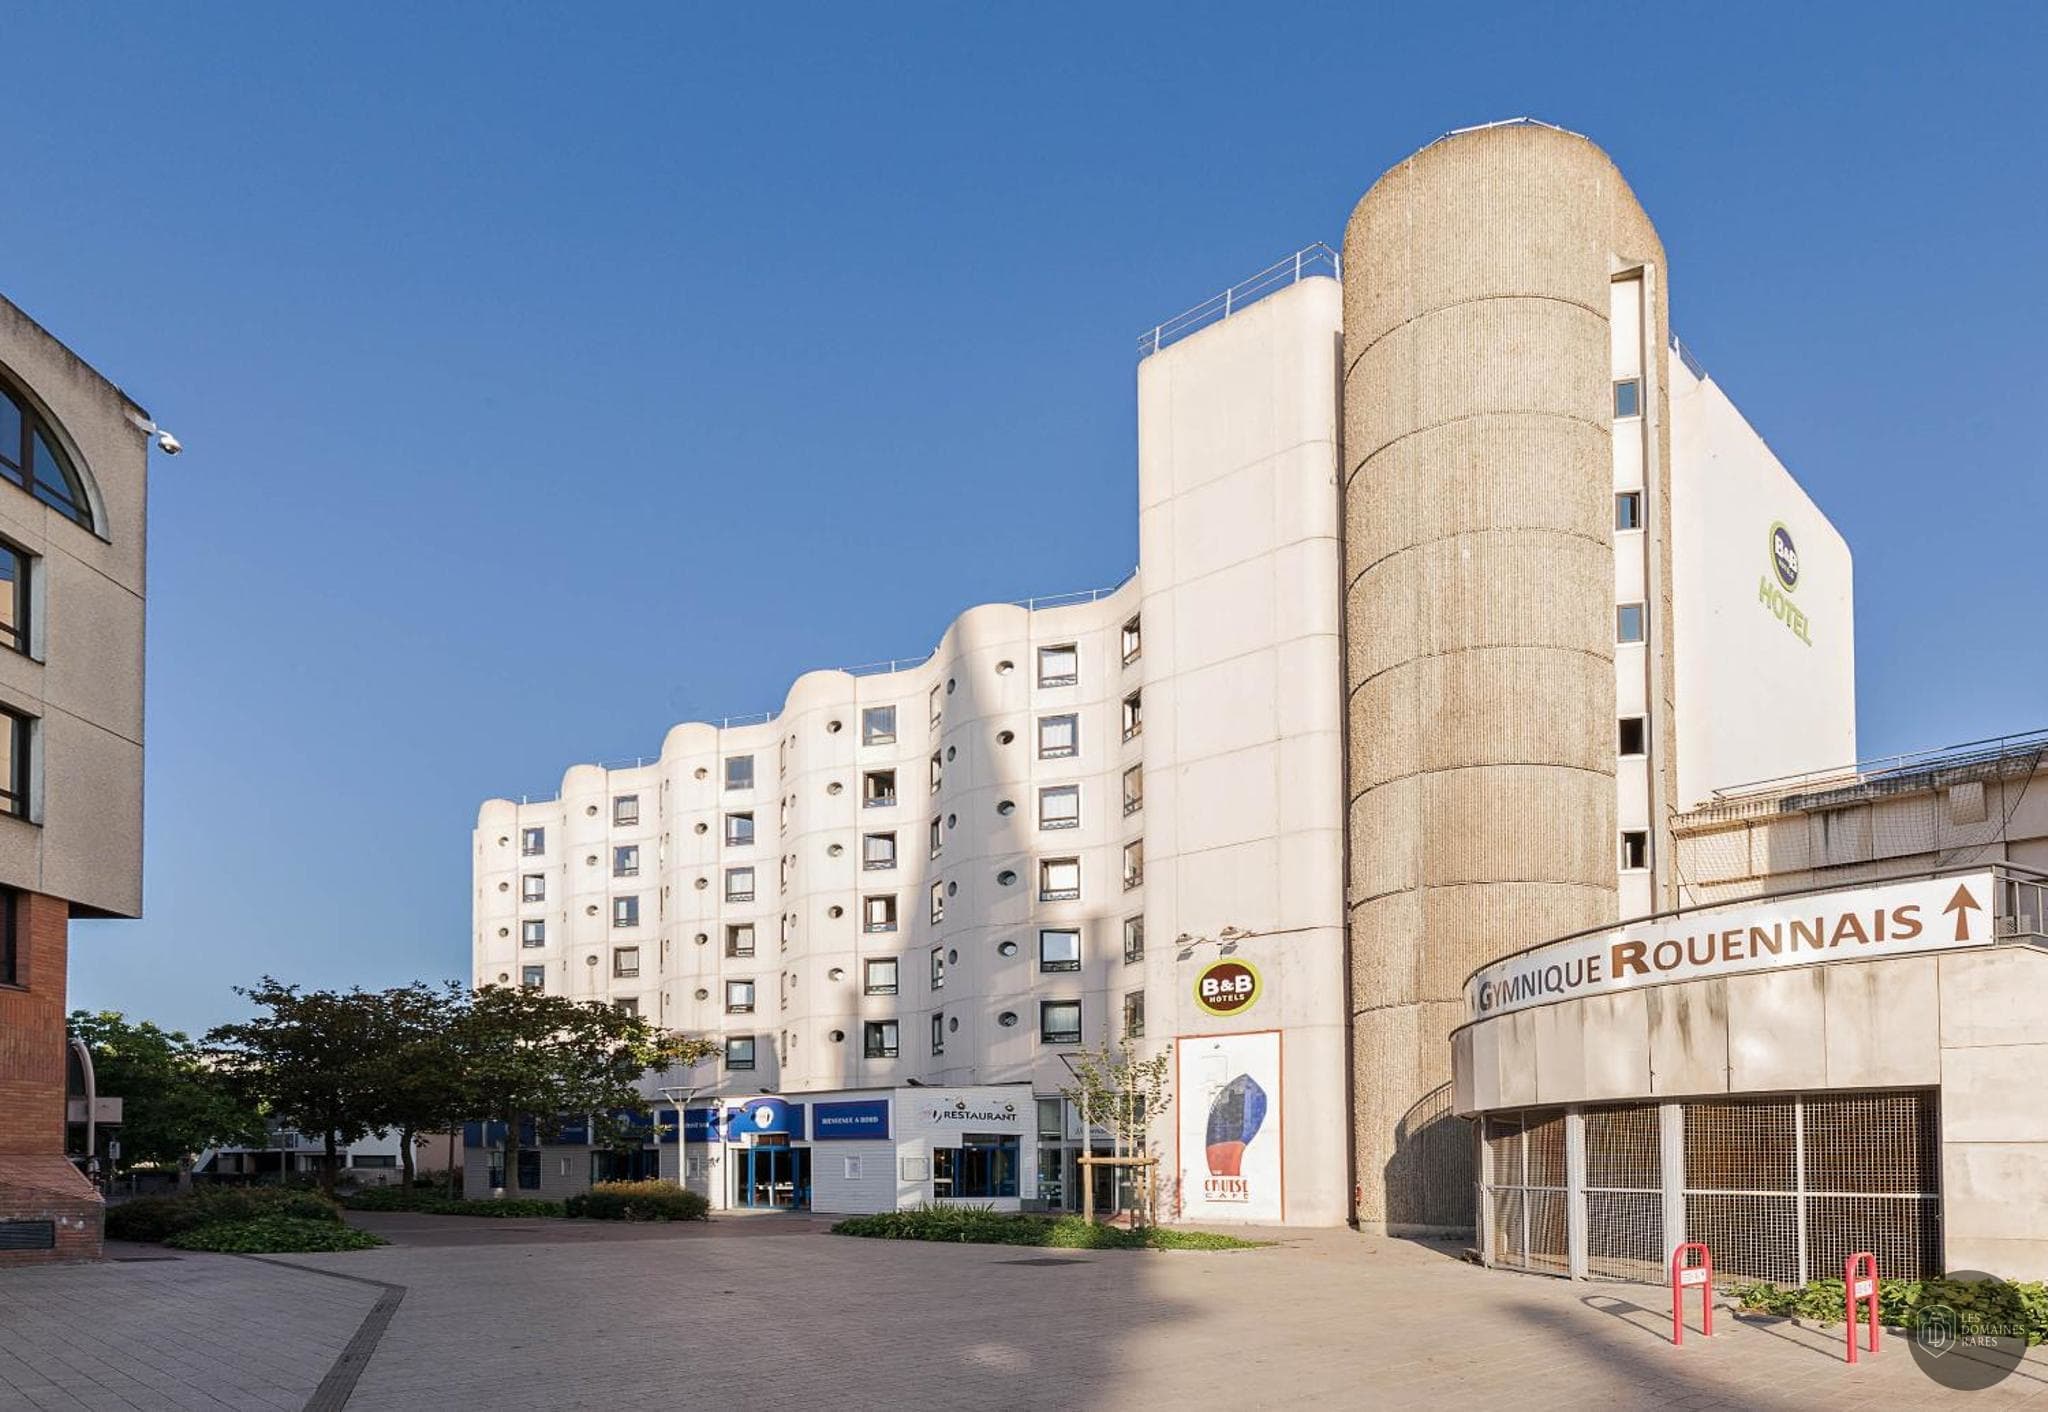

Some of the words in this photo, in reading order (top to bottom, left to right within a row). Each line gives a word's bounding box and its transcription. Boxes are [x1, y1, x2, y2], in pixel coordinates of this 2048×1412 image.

[1774, 534, 1798, 574] B&B
[1479, 955, 1601, 1012] GYMNIQUE
[1611, 904, 1924, 979] ROUENNAIS
[1202, 975, 1253, 997] B&B
[1208, 993, 1245, 1003] HOTELS
[944, 1111, 1017, 1121] RESTAURANT
[1204, 1179, 1248, 1192] CRUISE
